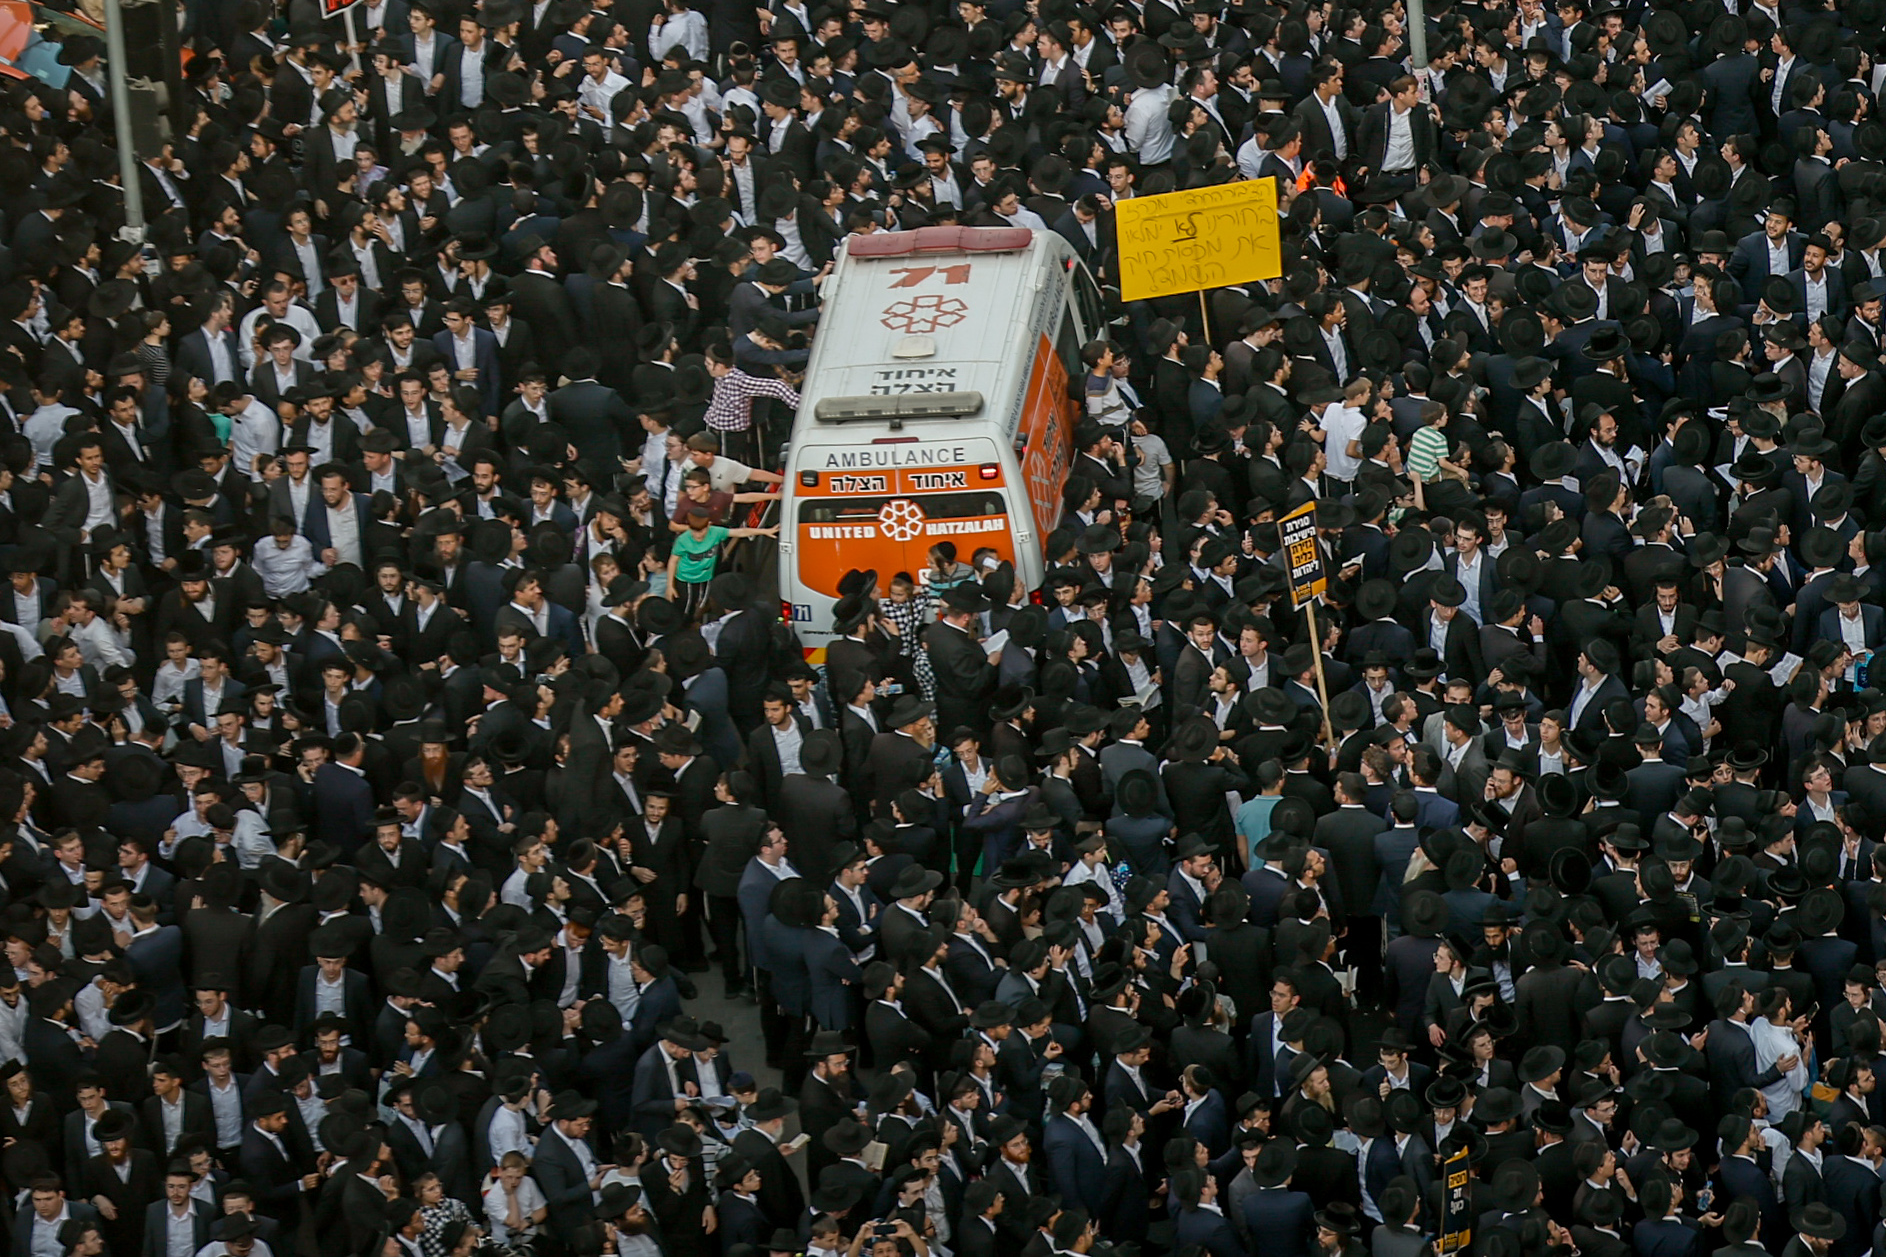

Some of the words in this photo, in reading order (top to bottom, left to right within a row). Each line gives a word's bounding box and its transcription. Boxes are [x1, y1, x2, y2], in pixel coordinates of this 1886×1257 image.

[1126, 218, 1163, 244] ימלאו
[1174, 211, 1203, 237] לא
[1161, 237, 1222, 269] מכסות
[1231, 233, 1271, 261] את
[1123, 251, 1157, 275] חוק
[887, 264, 971, 289] 71
[875, 368, 956, 380] איחוד
[871, 382, 955, 395] הצלה
[825, 447, 965, 468] AMBULANCE
[830, 475, 888, 493] הצלה
[908, 471, 968, 490] איחוד
[809, 526, 876, 539] UNITED
[925, 519, 1004, 536] HATZALAH
[1285, 515, 1310, 533] סגירת
[1283, 526, 1316, 546] הישיבות
[1291, 539, 1312, 555] גזירת
[1295, 550, 1312, 564] כליה
[1292, 559, 1319, 579] ליהדות
[795, 606, 810, 620] 71
